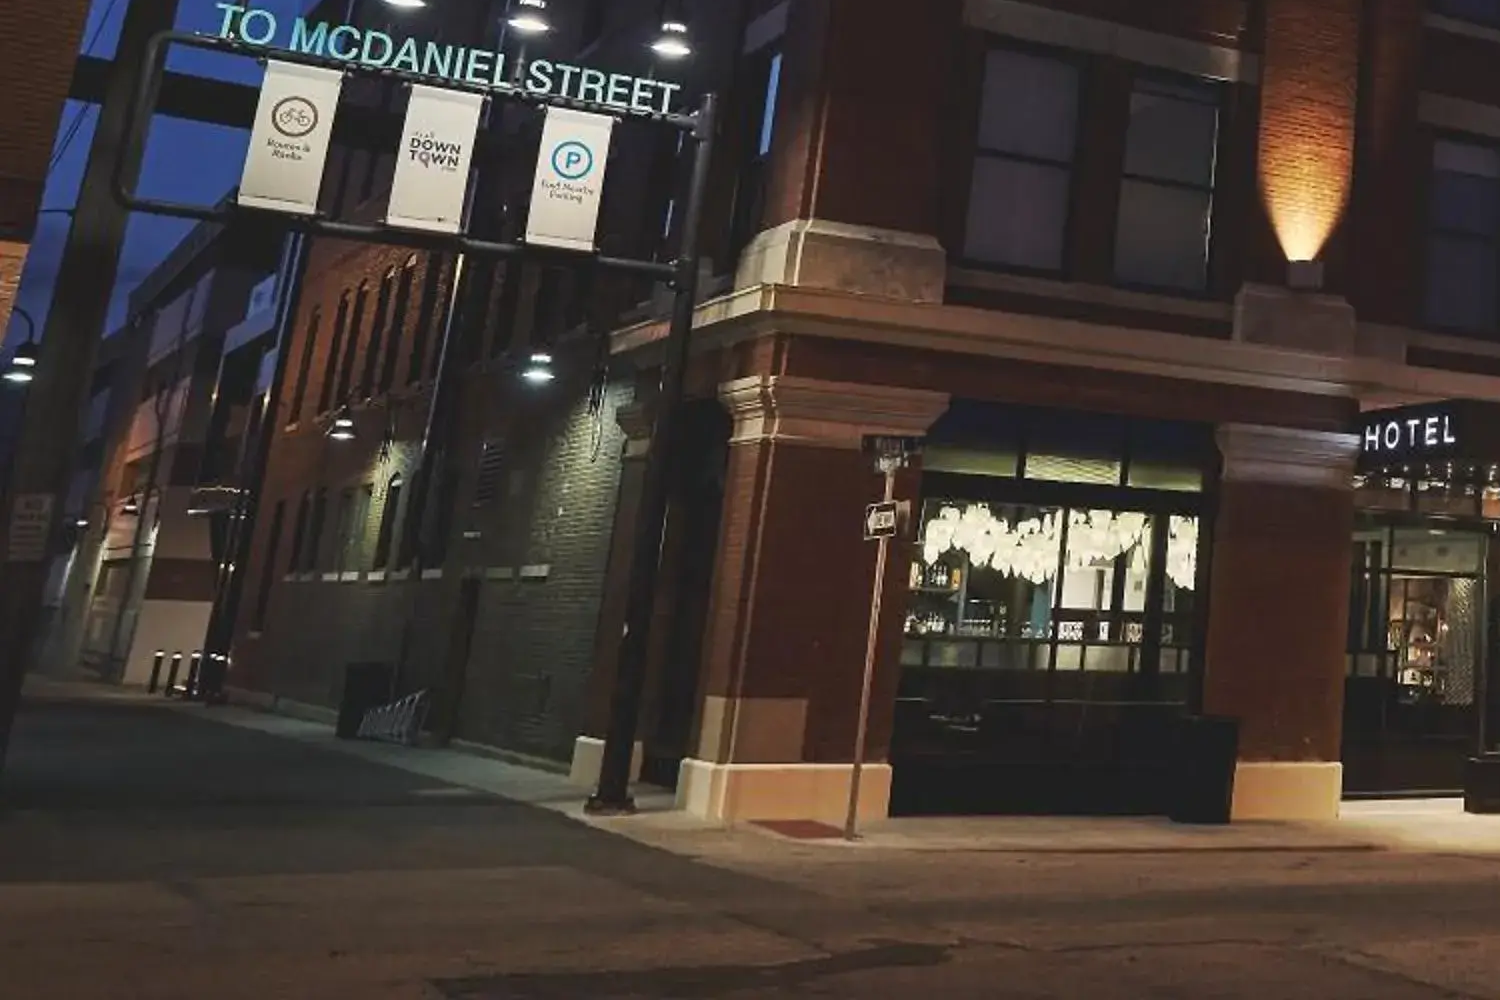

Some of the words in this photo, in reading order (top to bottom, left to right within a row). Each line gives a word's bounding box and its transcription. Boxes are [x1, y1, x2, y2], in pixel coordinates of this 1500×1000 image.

[215, 2, 276, 45] TO
[289, 17, 511, 91] MCDANIEL
[525, 58, 680, 115] STREET
[410, 137, 461, 155] DOWN
[409, 149, 460, 168] TOWN
[565, 151, 581, 168] P
[1364, 415, 1456, 453] HOTEL
